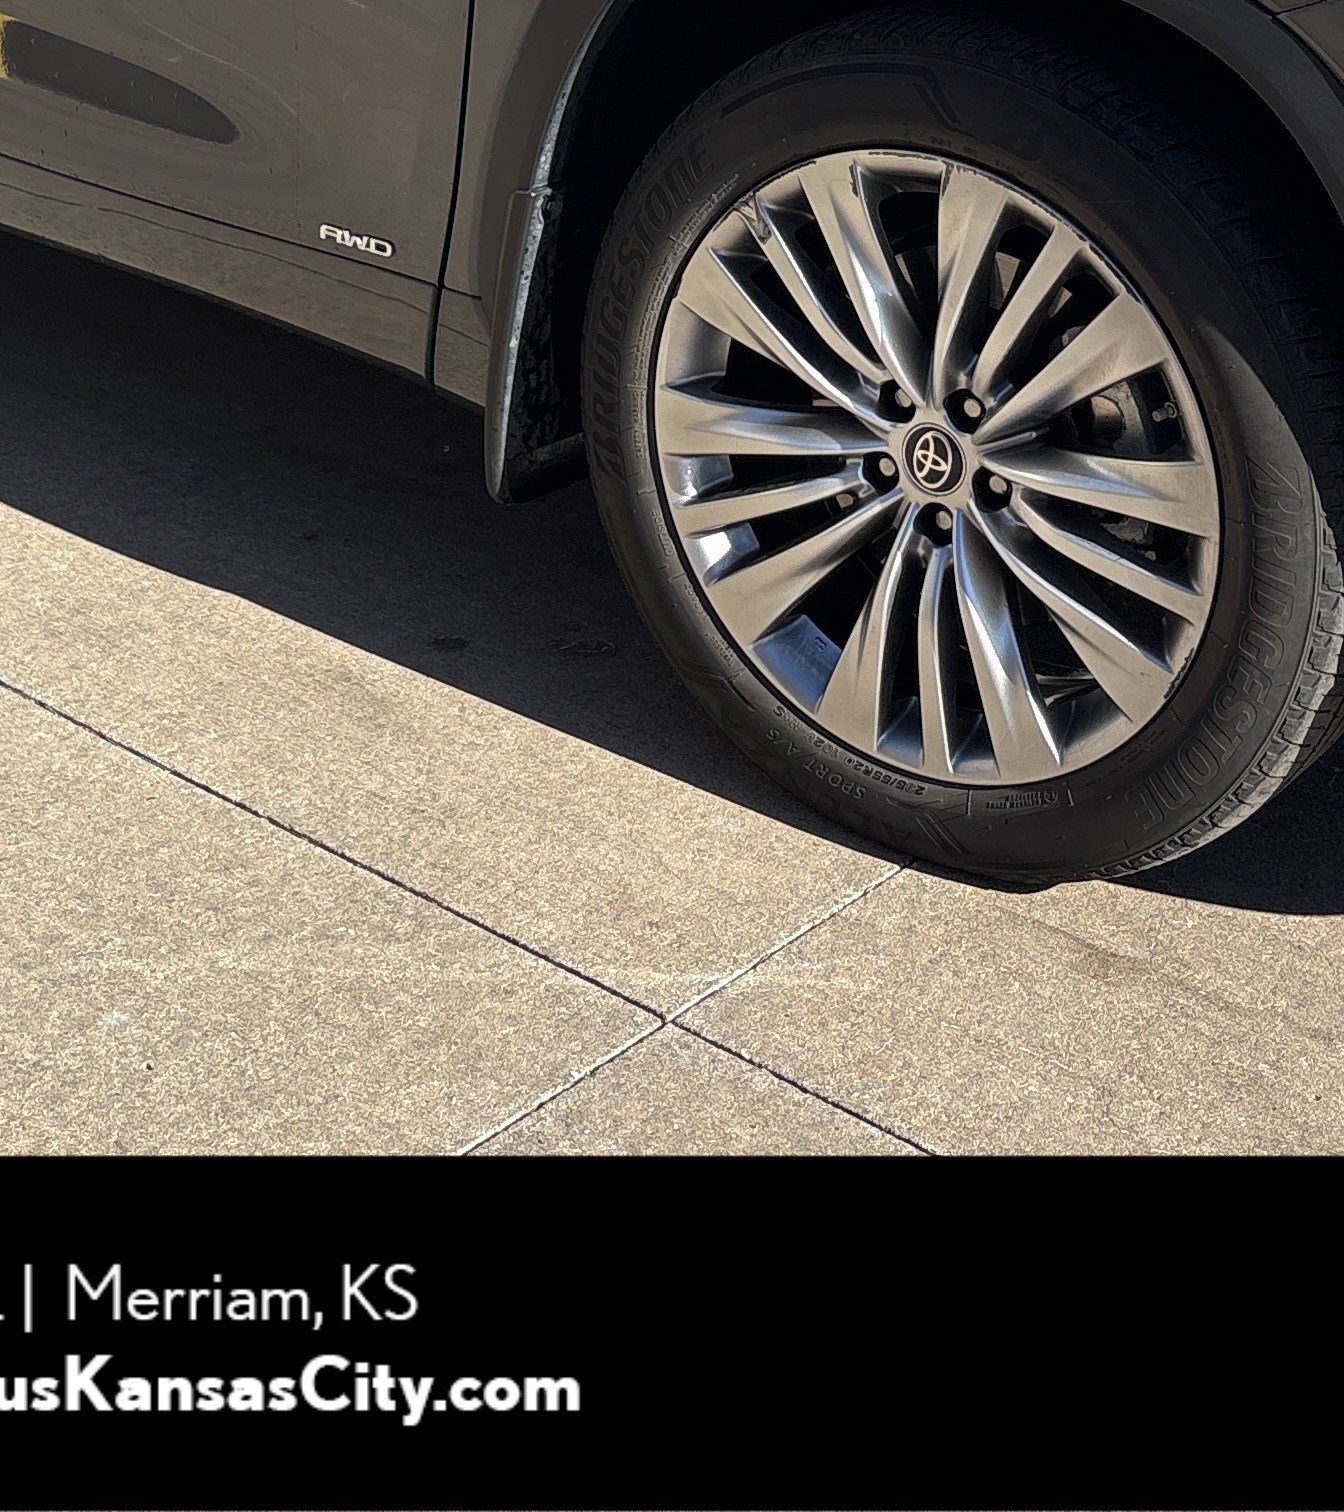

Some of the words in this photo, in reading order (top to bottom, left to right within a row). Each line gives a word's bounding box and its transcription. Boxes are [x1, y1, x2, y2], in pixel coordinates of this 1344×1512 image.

[319, 223, 393, 258] AWD
[591, 130, 714, 487] BRIDGESTONE
[1125, 454, 1304, 832] BRIDGESTONE
[803, 759, 868, 801] SPORT
